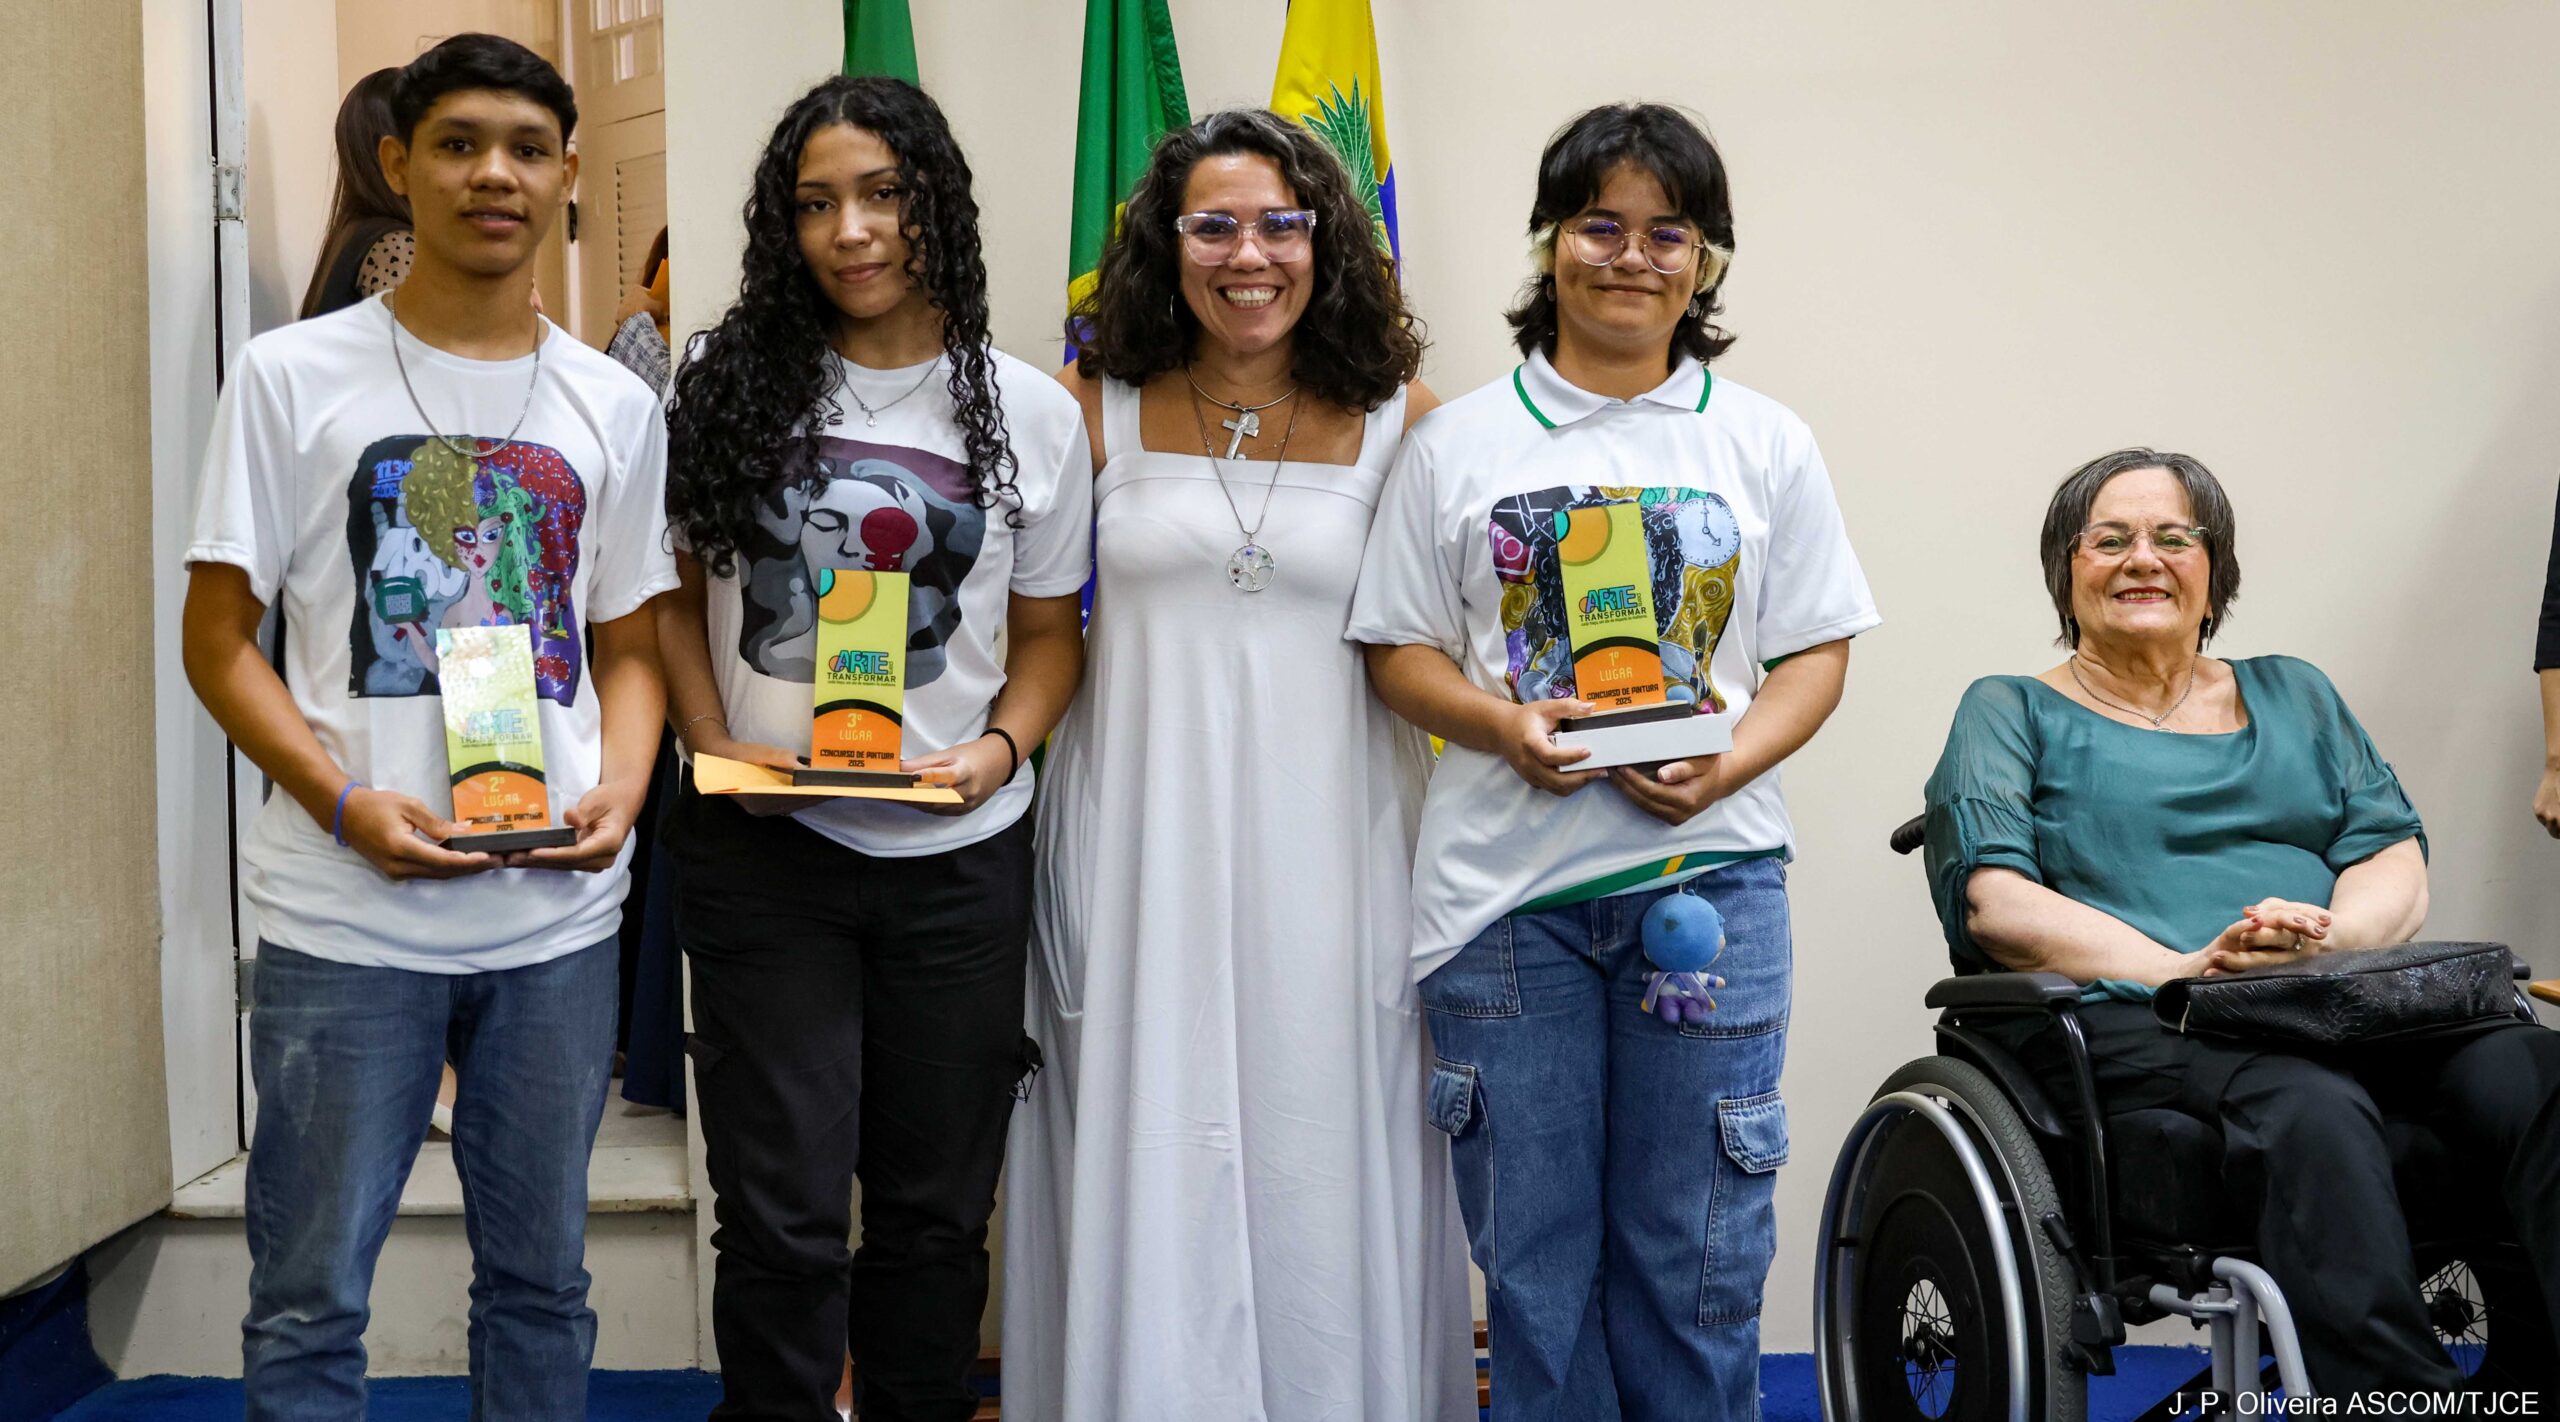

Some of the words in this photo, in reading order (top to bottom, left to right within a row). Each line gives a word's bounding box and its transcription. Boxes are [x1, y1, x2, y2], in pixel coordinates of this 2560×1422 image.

[1585, 584, 1638, 614] ARTE
[1579, 606, 1647, 622] TRANSFORMAR
[834, 649, 889, 675] ARTE
[827, 672, 896, 683] TRANSFORMAR
[1599, 666, 1633, 682] LUGAR
[1586, 688, 1621, 700] CONCURSO
[1622, 687, 1630, 696] DE
[1631, 683, 1659, 694] PINTURA
[1615, 697, 1632, 706] 2025
[839, 729, 873, 741] LUGAR
[820, 749, 855, 758] CONCURSO
[856, 750, 865, 758] DE
[866, 751, 895, 760] PINTURA
[848, 759, 865, 767] 2025
[483, 794, 519, 807] LUGAR
[503, 814, 512, 822] DE
